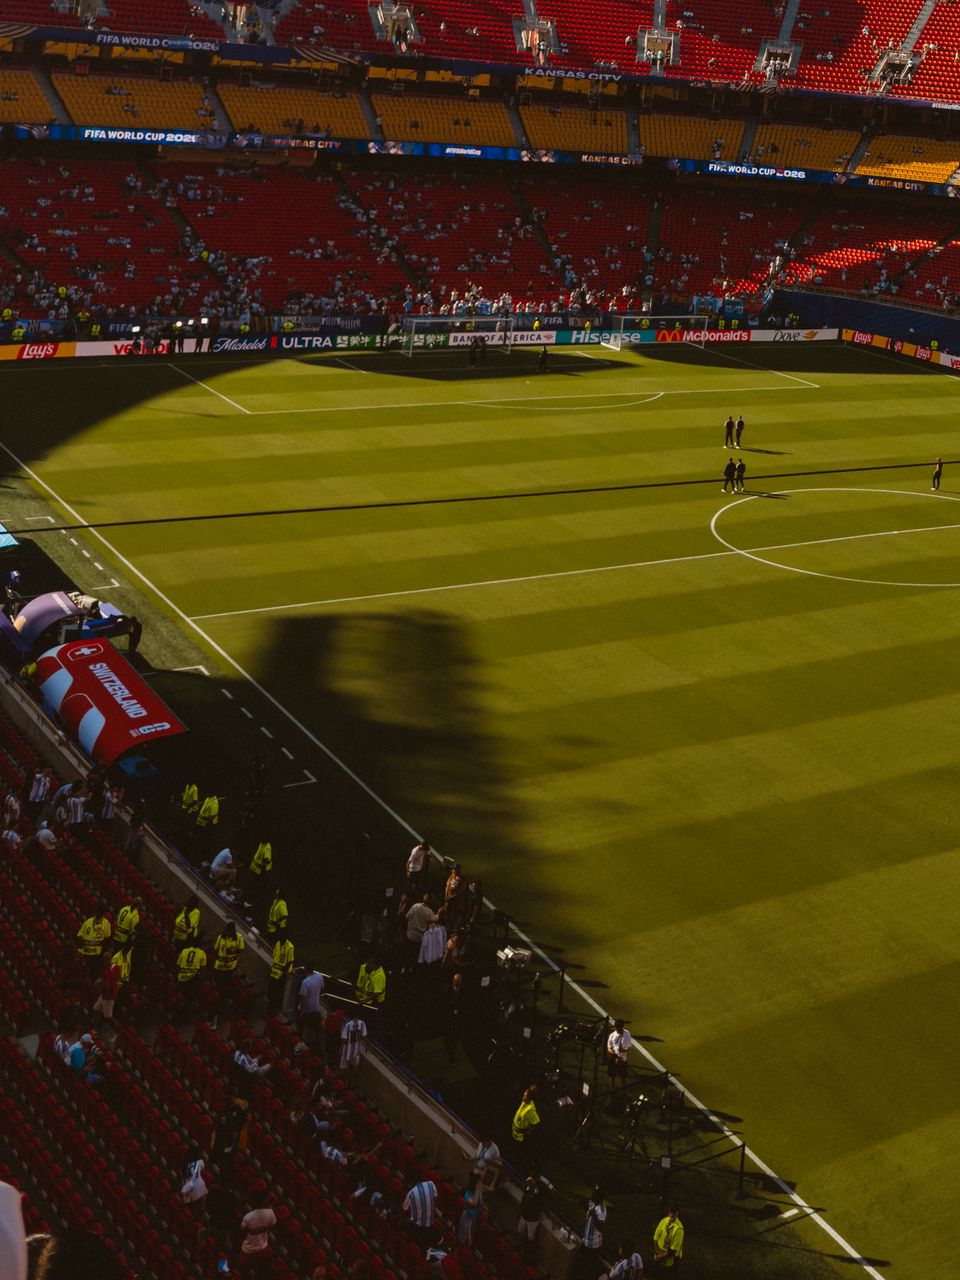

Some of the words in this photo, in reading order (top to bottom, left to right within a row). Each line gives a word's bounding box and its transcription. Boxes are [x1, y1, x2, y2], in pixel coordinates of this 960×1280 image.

[97, 34, 119, 44] FIFA
[121, 36, 160, 47] WORLD
[189, 41, 219, 51] 026
[525, 68, 586, 79] KANSAS
[588, 73, 622, 81] CITY
[85, 129, 107, 139] FIFA
[108, 130, 144, 140] WORLD
[145, 132, 165, 141] CUP
[317, 140, 341, 149] CITY
[581, 154, 620, 164] KANSAS
[728, 166, 758, 175] WORLD
[759, 168, 776, 176] CUP
[776, 169, 806, 179] 026
[868, 178, 904, 189] KANSAS
[904, 182, 925, 191] CITY
[544, 316, 563, 325] FIFA
[109, 323, 133, 333] FIFA
[453, 335, 478, 343] BAN
[484, 334, 496, 342] OF
[499, 333, 542, 342] AMERICA
[571, 330, 641, 343] Hisense
[682, 330, 749, 342] McDonald's
[772, 330, 800, 342] Dove
[854, 331, 872, 344] Lay's
[22, 343, 55, 359] Lay's
[213, 338, 267, 352] Michelob
[282, 337, 332, 349] ULTRA
[916, 346, 931, 360] Lay's
[88, 662, 148, 718] SWITZERLAND
